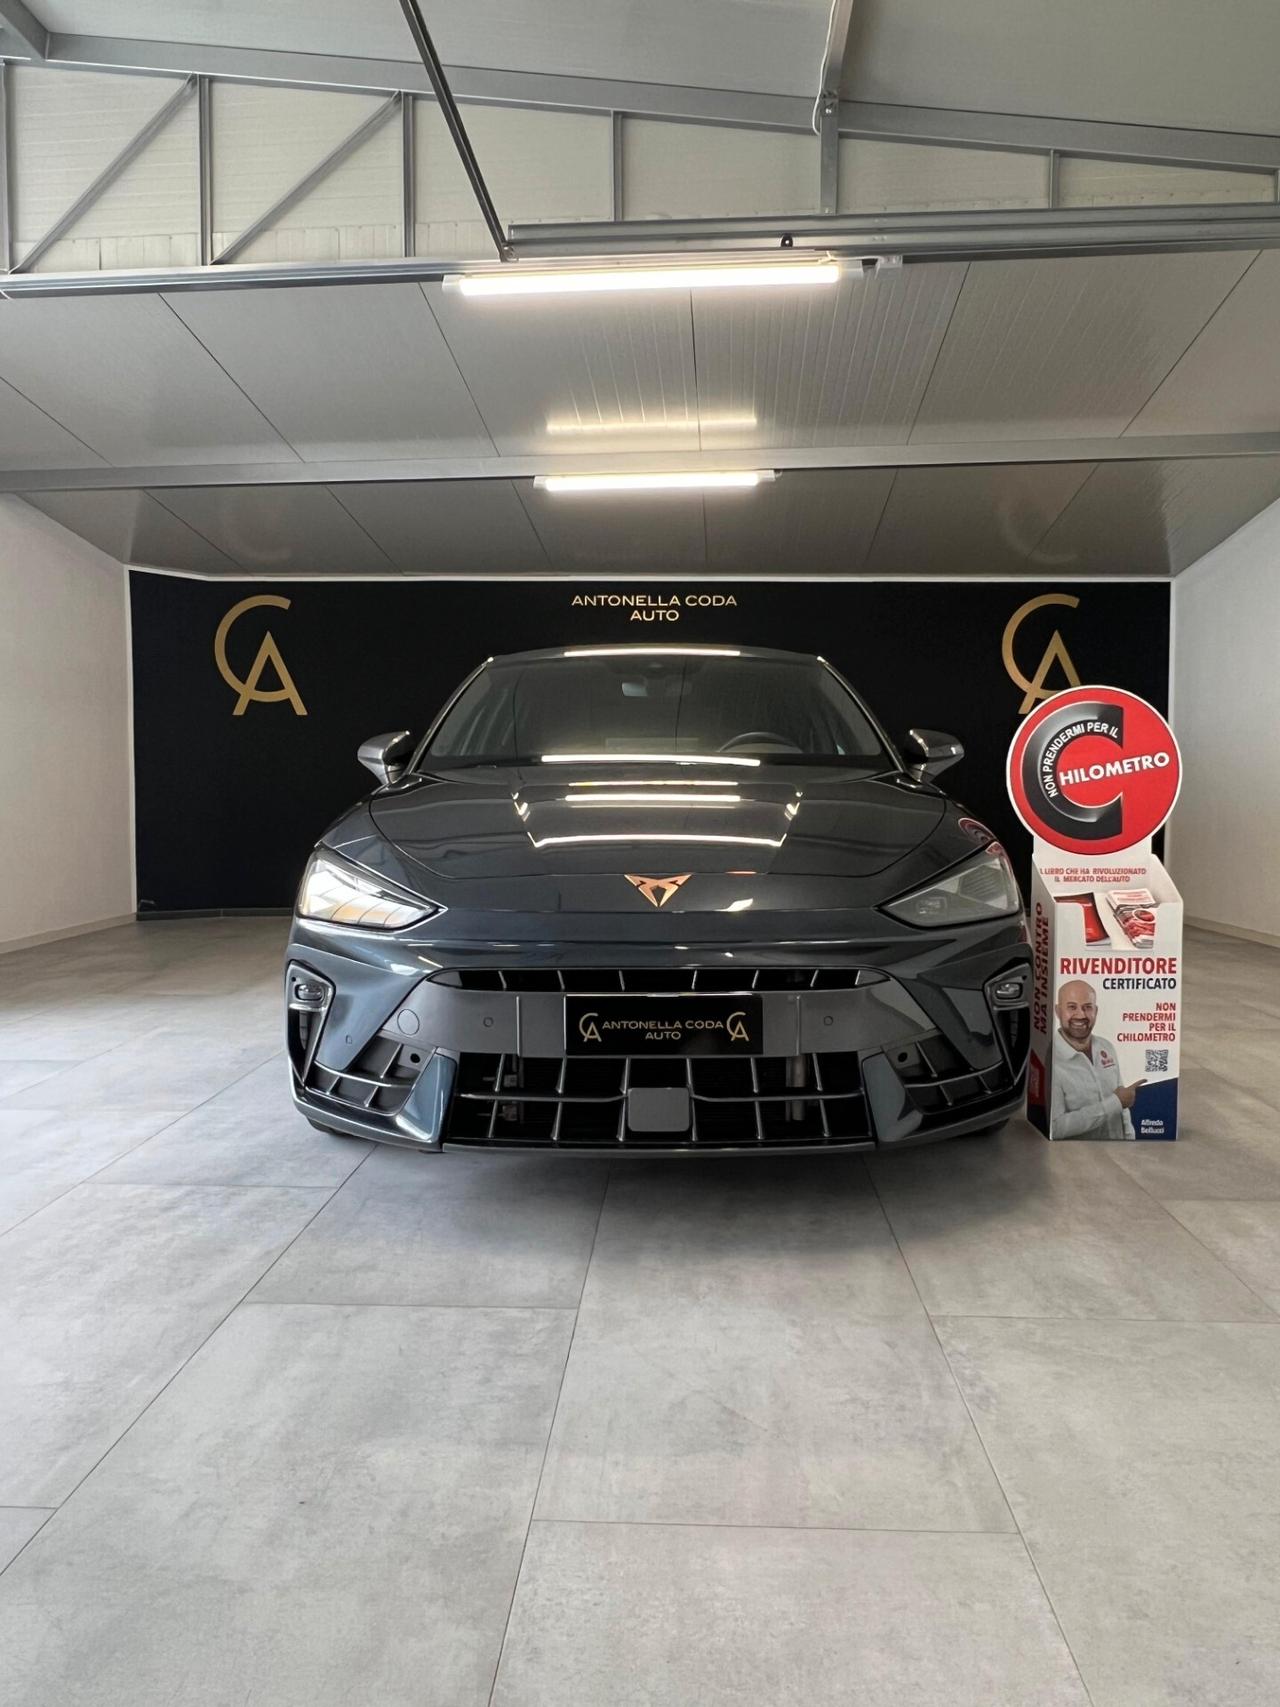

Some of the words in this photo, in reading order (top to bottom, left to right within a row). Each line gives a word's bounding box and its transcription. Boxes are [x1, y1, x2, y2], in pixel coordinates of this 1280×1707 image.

[571, 595, 681, 606] ANTONELLA
[685, 595, 738, 606] CODA
[630, 610, 679, 621] AUTO
[1087, 722, 1108, 733] PER
[1108, 726, 1119, 738] IL
[1042, 724, 1085, 773] PRENDERMI
[1042, 775, 1058, 798] NON
[1041, 917, 1049, 998] INSIEME
[1060, 957, 1177, 975] RIVENDITORE
[1103, 978, 1177, 990] CERTIFICATO
[1156, 1002, 1176, 1011] NON
[1040, 1003, 1048, 1034] MA
[1123, 1013, 1176, 1021] PRENDERMI
[602, 1020, 682, 1030] ANTONELLA
[685, 1020, 724, 1029] CODA
[1149, 1023, 1166, 1031] PER
[1168, 1023, 1176, 1031] IL
[645, 1031, 682, 1040] AUTO
[1117, 1033, 1176, 1042] CHILOMETRO
